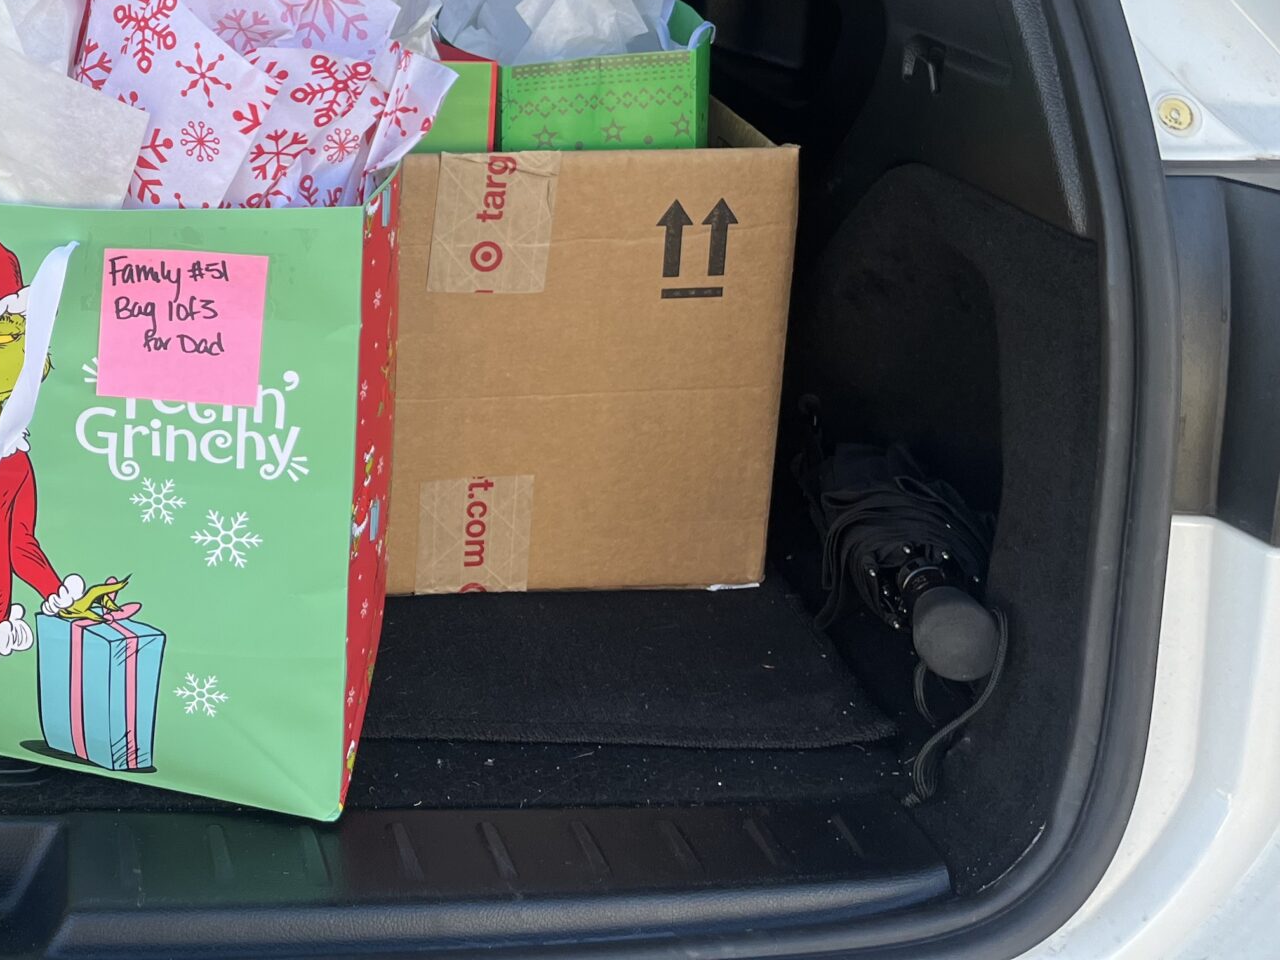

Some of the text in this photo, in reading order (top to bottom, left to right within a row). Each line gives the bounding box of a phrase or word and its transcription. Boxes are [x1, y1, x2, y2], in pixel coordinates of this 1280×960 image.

[108, 255, 229, 303] Family #51
[114, 296, 157, 332] Bag
[176, 332, 225, 356] Dad
[75, 406, 301, 481] Grinchy
[463, 476, 494, 567] t.com
